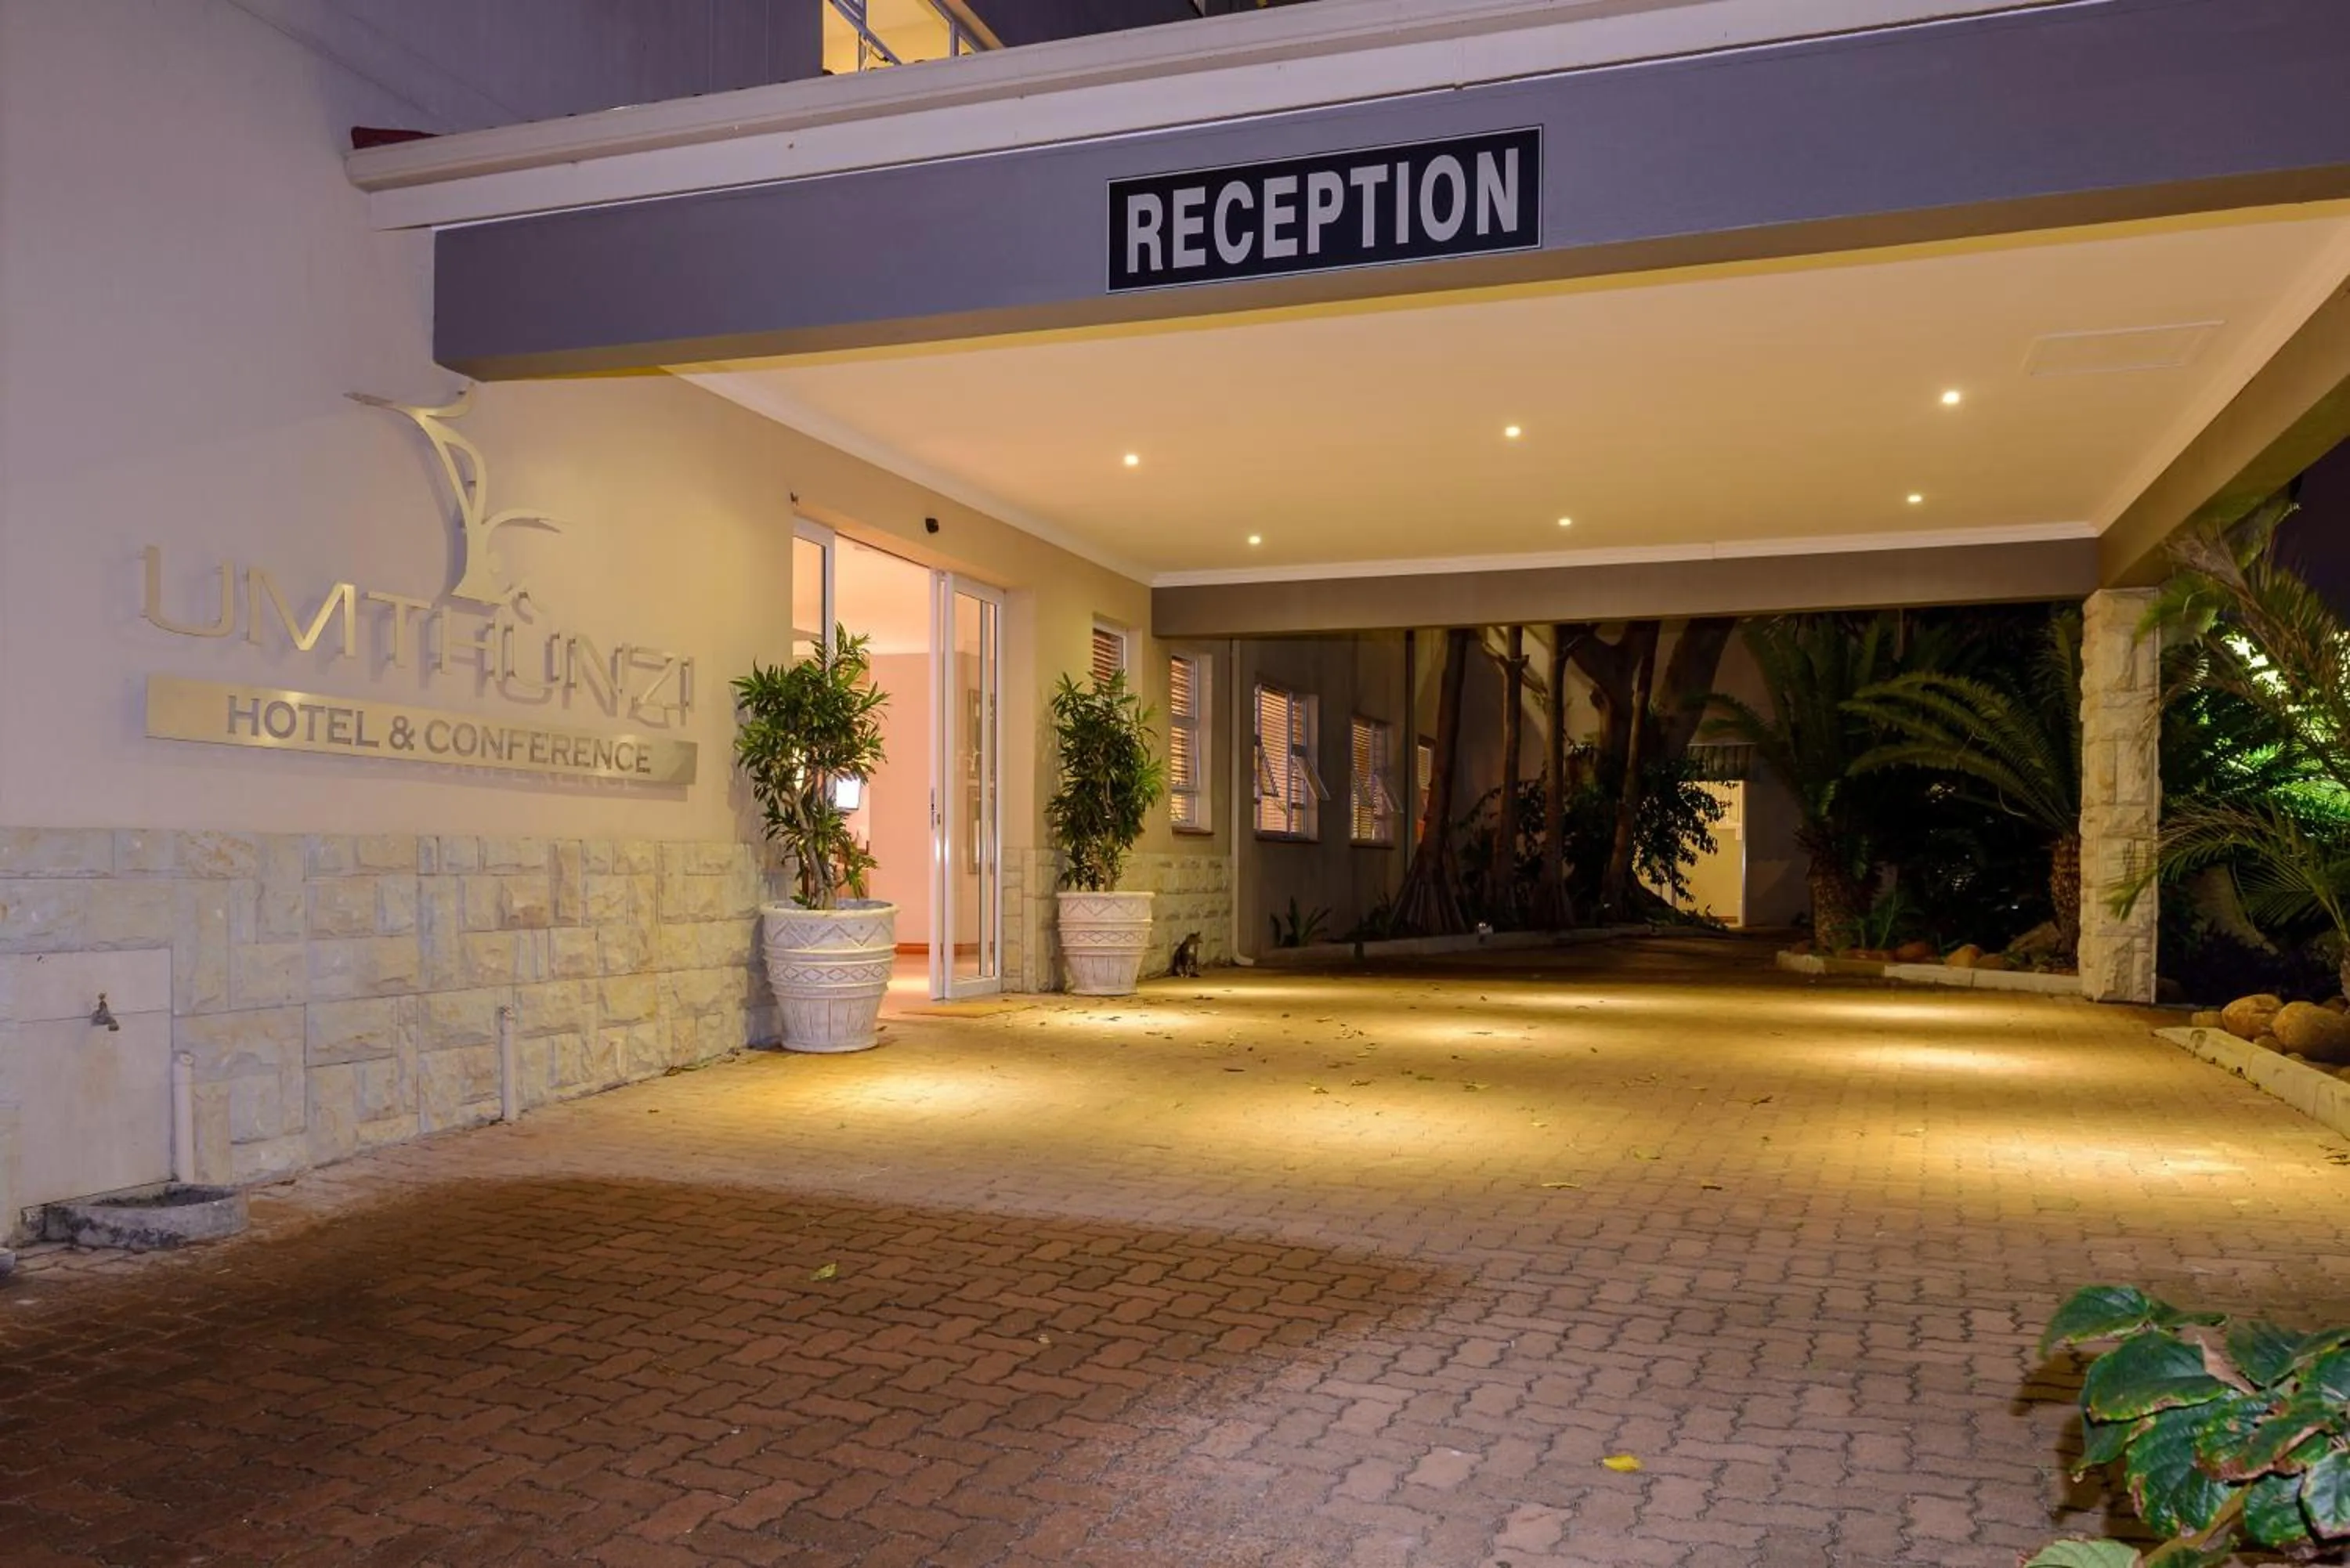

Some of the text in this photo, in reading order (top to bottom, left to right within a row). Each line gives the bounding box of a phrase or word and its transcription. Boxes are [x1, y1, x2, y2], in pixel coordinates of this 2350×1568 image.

[1126, 147, 1519, 273] RECEPTION
[143, 545, 695, 714] UMTHUNZI
[226, 694, 653, 775] HOTEL & CONFERENCE
